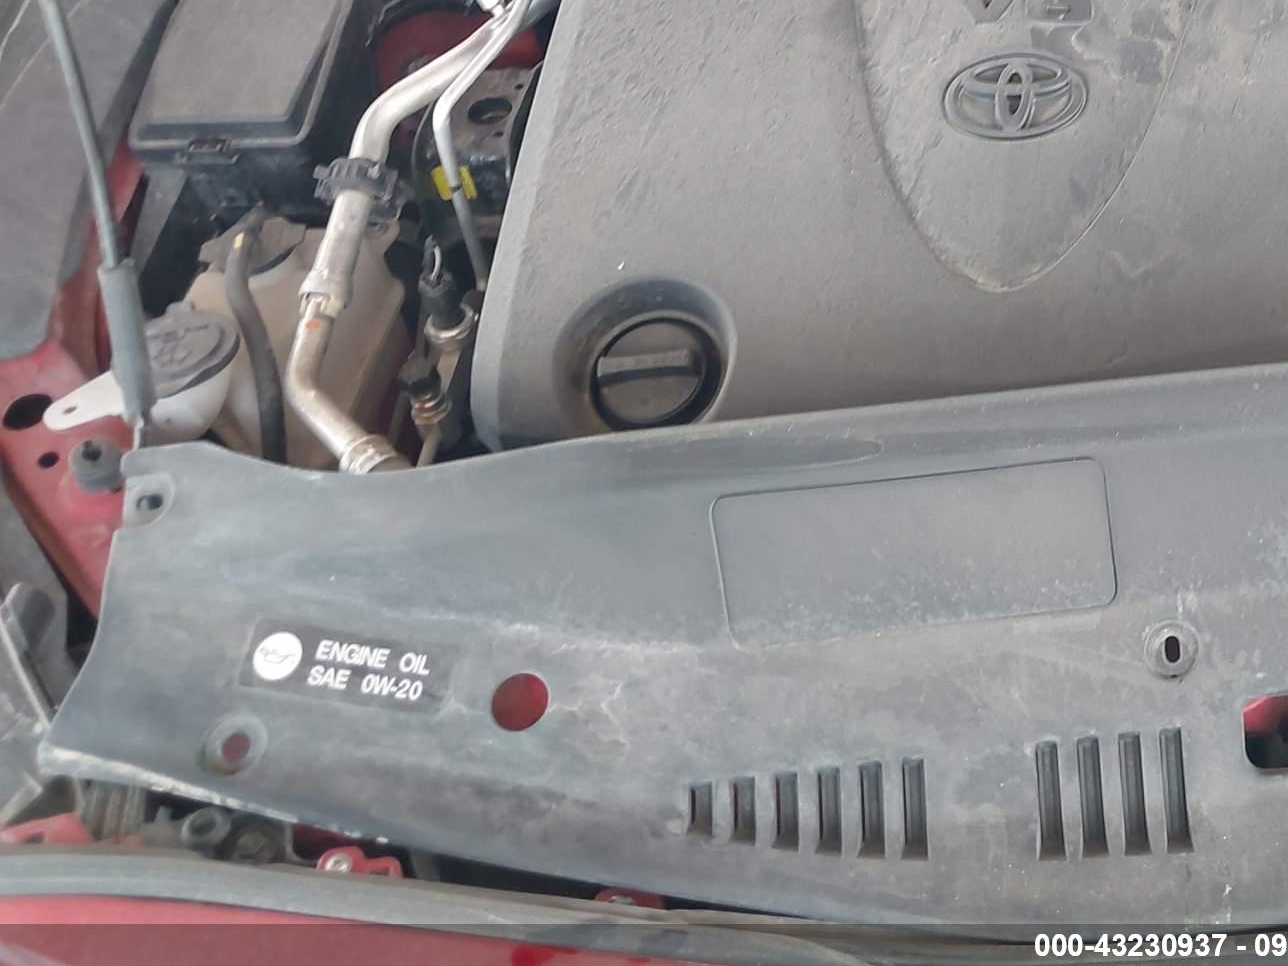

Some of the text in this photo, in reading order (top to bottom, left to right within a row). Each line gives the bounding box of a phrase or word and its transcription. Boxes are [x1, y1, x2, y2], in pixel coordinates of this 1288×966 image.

[315, 639, 431, 676] ENGINE OIL
[307, 665, 423, 700] SAE 0W-20
